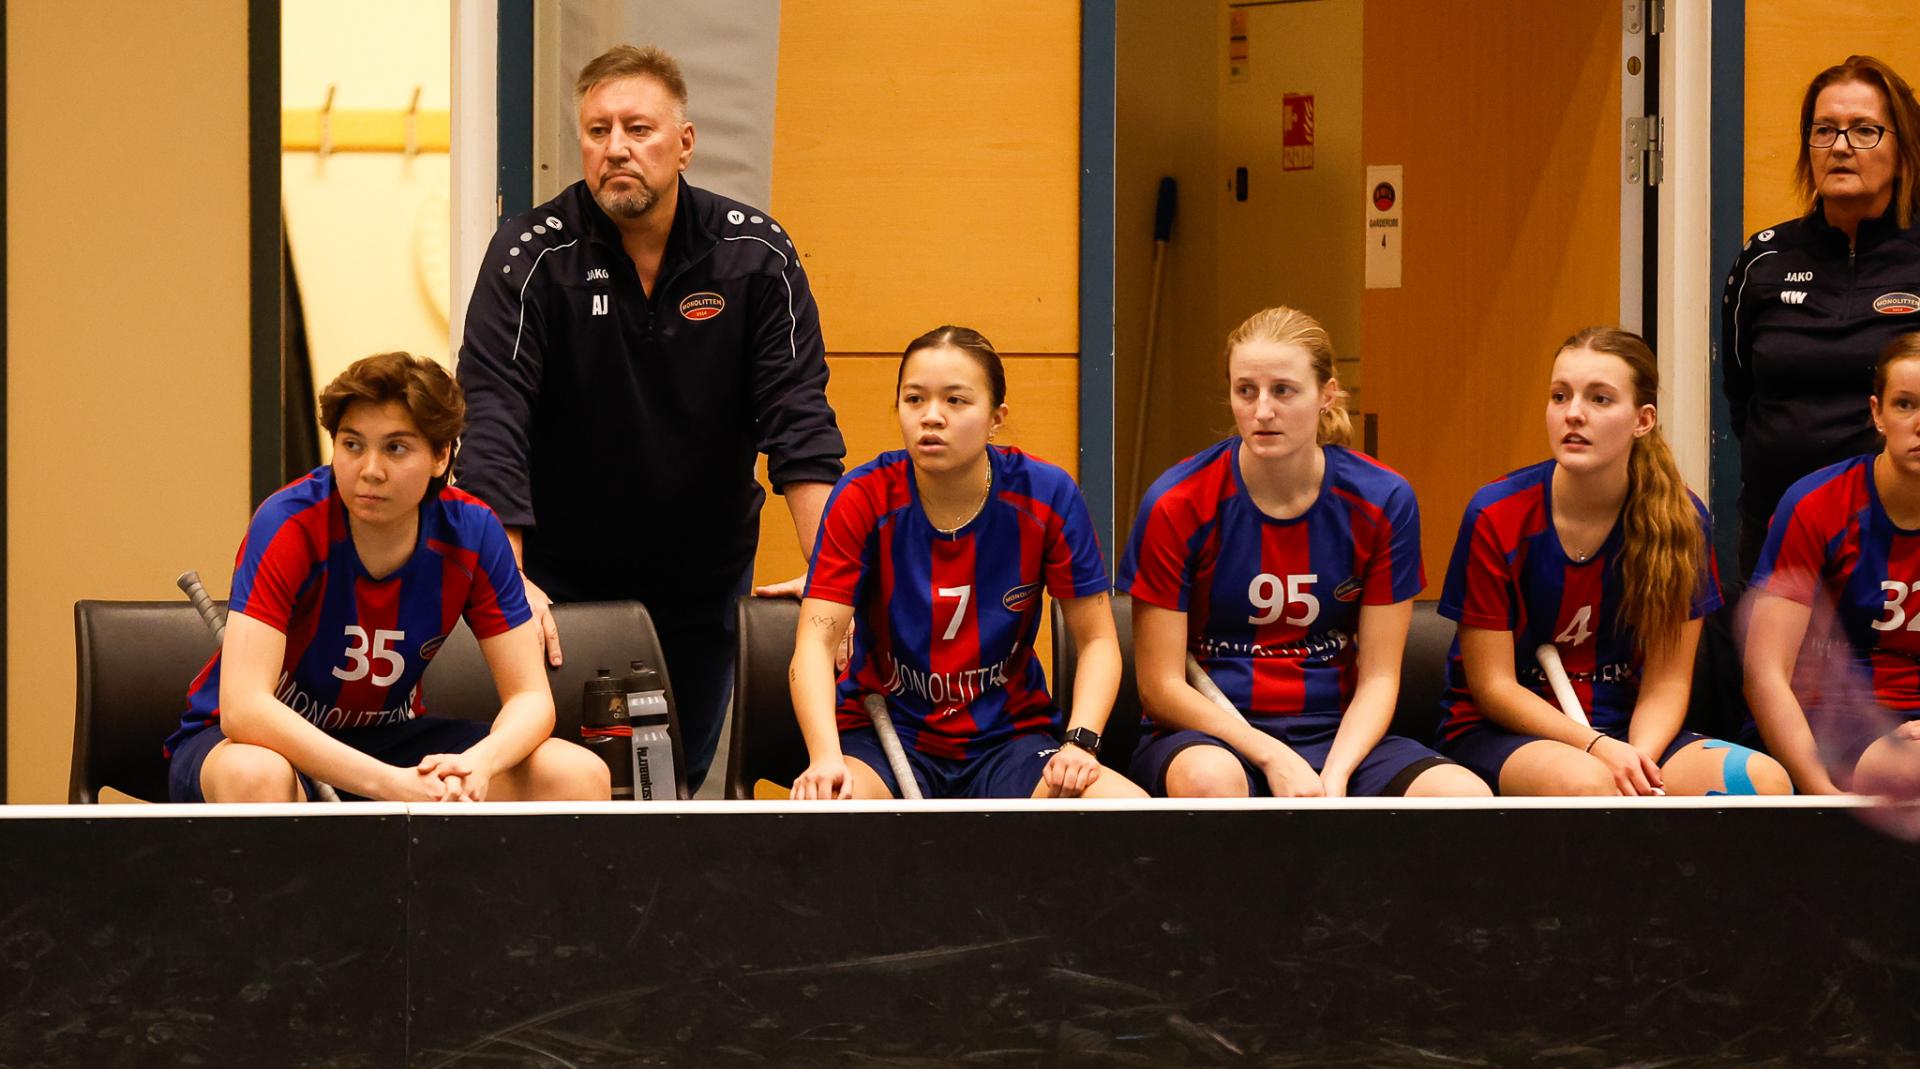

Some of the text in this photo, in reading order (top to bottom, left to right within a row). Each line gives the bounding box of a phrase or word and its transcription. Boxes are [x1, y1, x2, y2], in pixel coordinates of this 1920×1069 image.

[586, 268, 610, 281] JAKO
[1784, 271, 1813, 282] JAKO
[592, 294, 609, 316] AJ
[938, 584, 971, 640] 7
[1247, 573, 1320, 627] 95
[1871, 580, 1920, 631] 32
[1554, 605, 1592, 646] 4
[331, 625, 406, 687] 35
